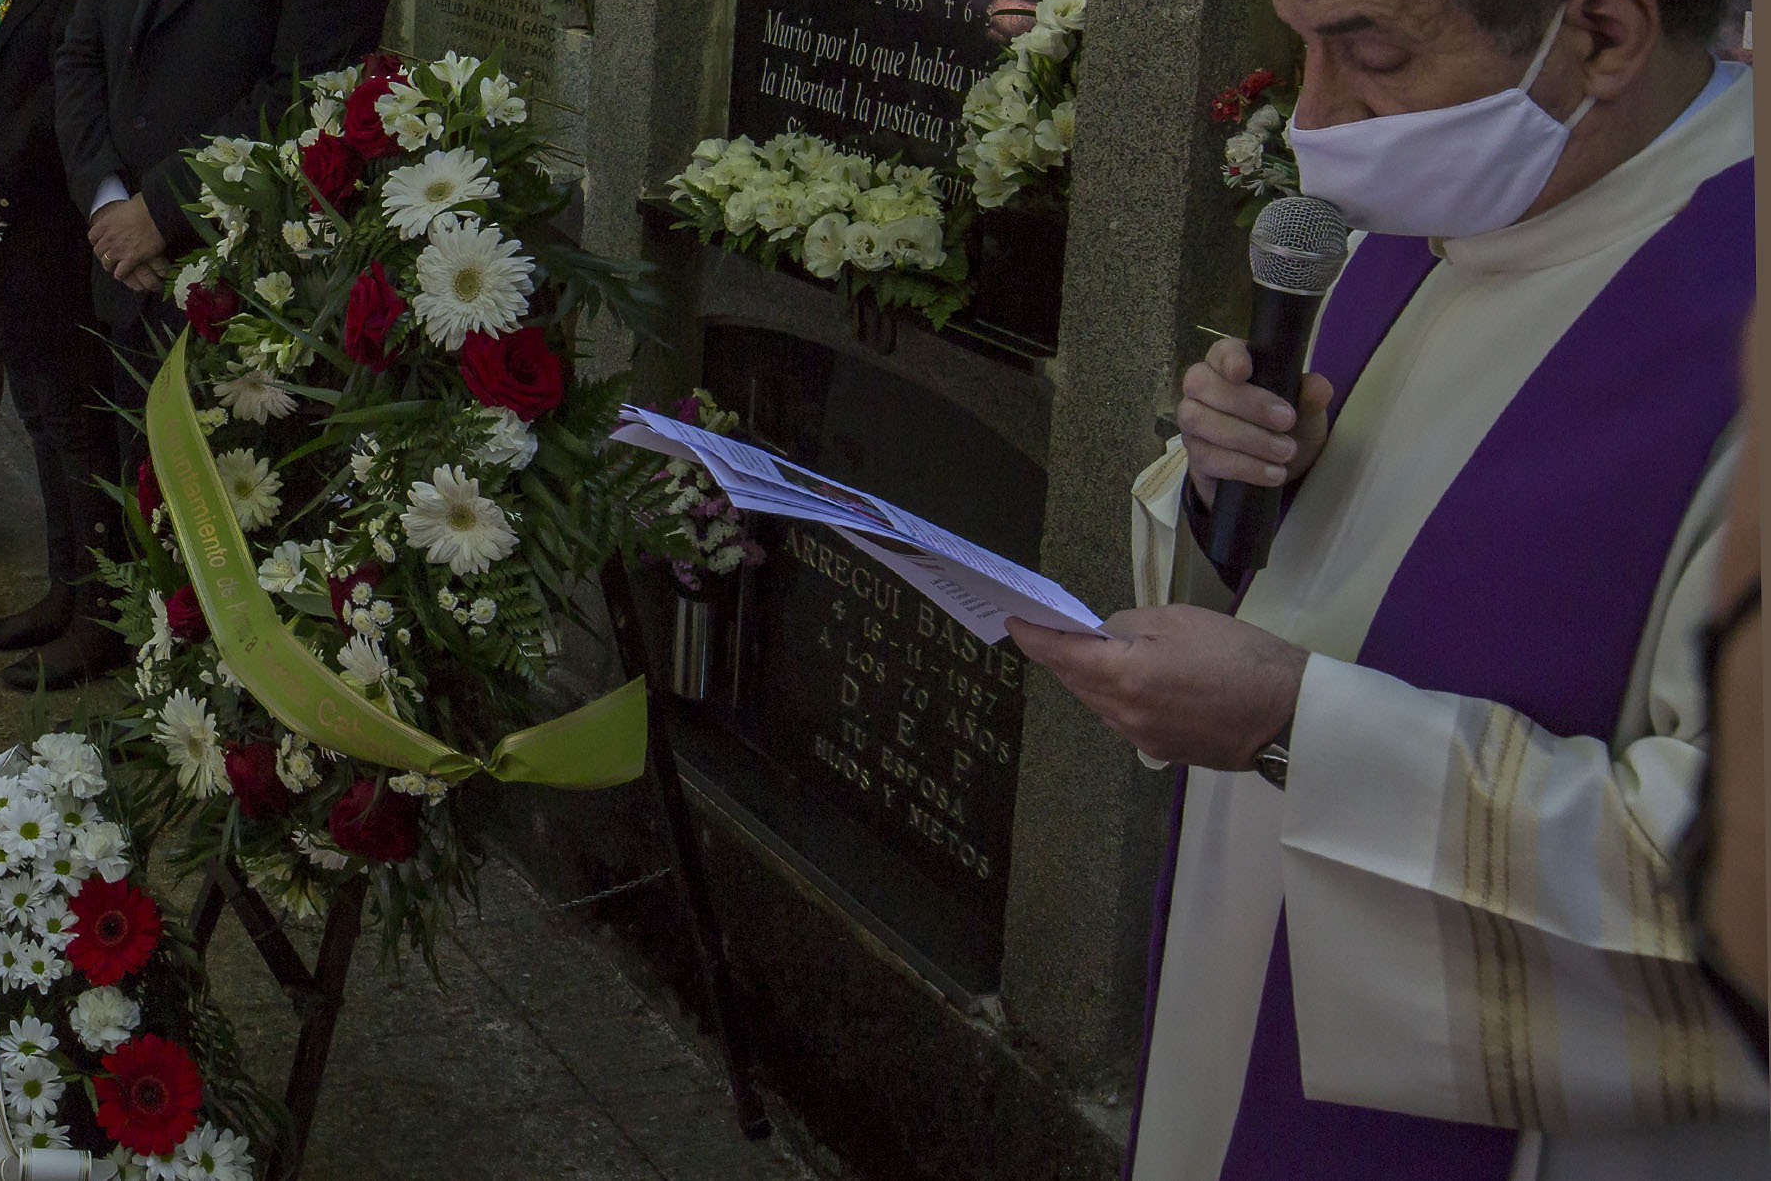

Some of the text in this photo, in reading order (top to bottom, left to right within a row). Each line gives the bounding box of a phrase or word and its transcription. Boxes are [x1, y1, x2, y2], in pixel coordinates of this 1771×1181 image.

[762, 9, 812, 55] Murió
[812, 30, 847, 67] por
[849, 27, 867, 69] lo
[871, 46, 905, 83] que
[909, 41, 965, 93] había
[759, 57, 775, 96] la
[780, 62, 847, 119] libertad,
[853, 82, 871, 124] la
[869, 93, 944, 144] justicia
[784, 525, 901, 619] ARREGUI
[846, 641, 886, 683] LOS
[881, 746, 965, 825] ESPOSA
[909, 802, 989, 880] NIETOS
